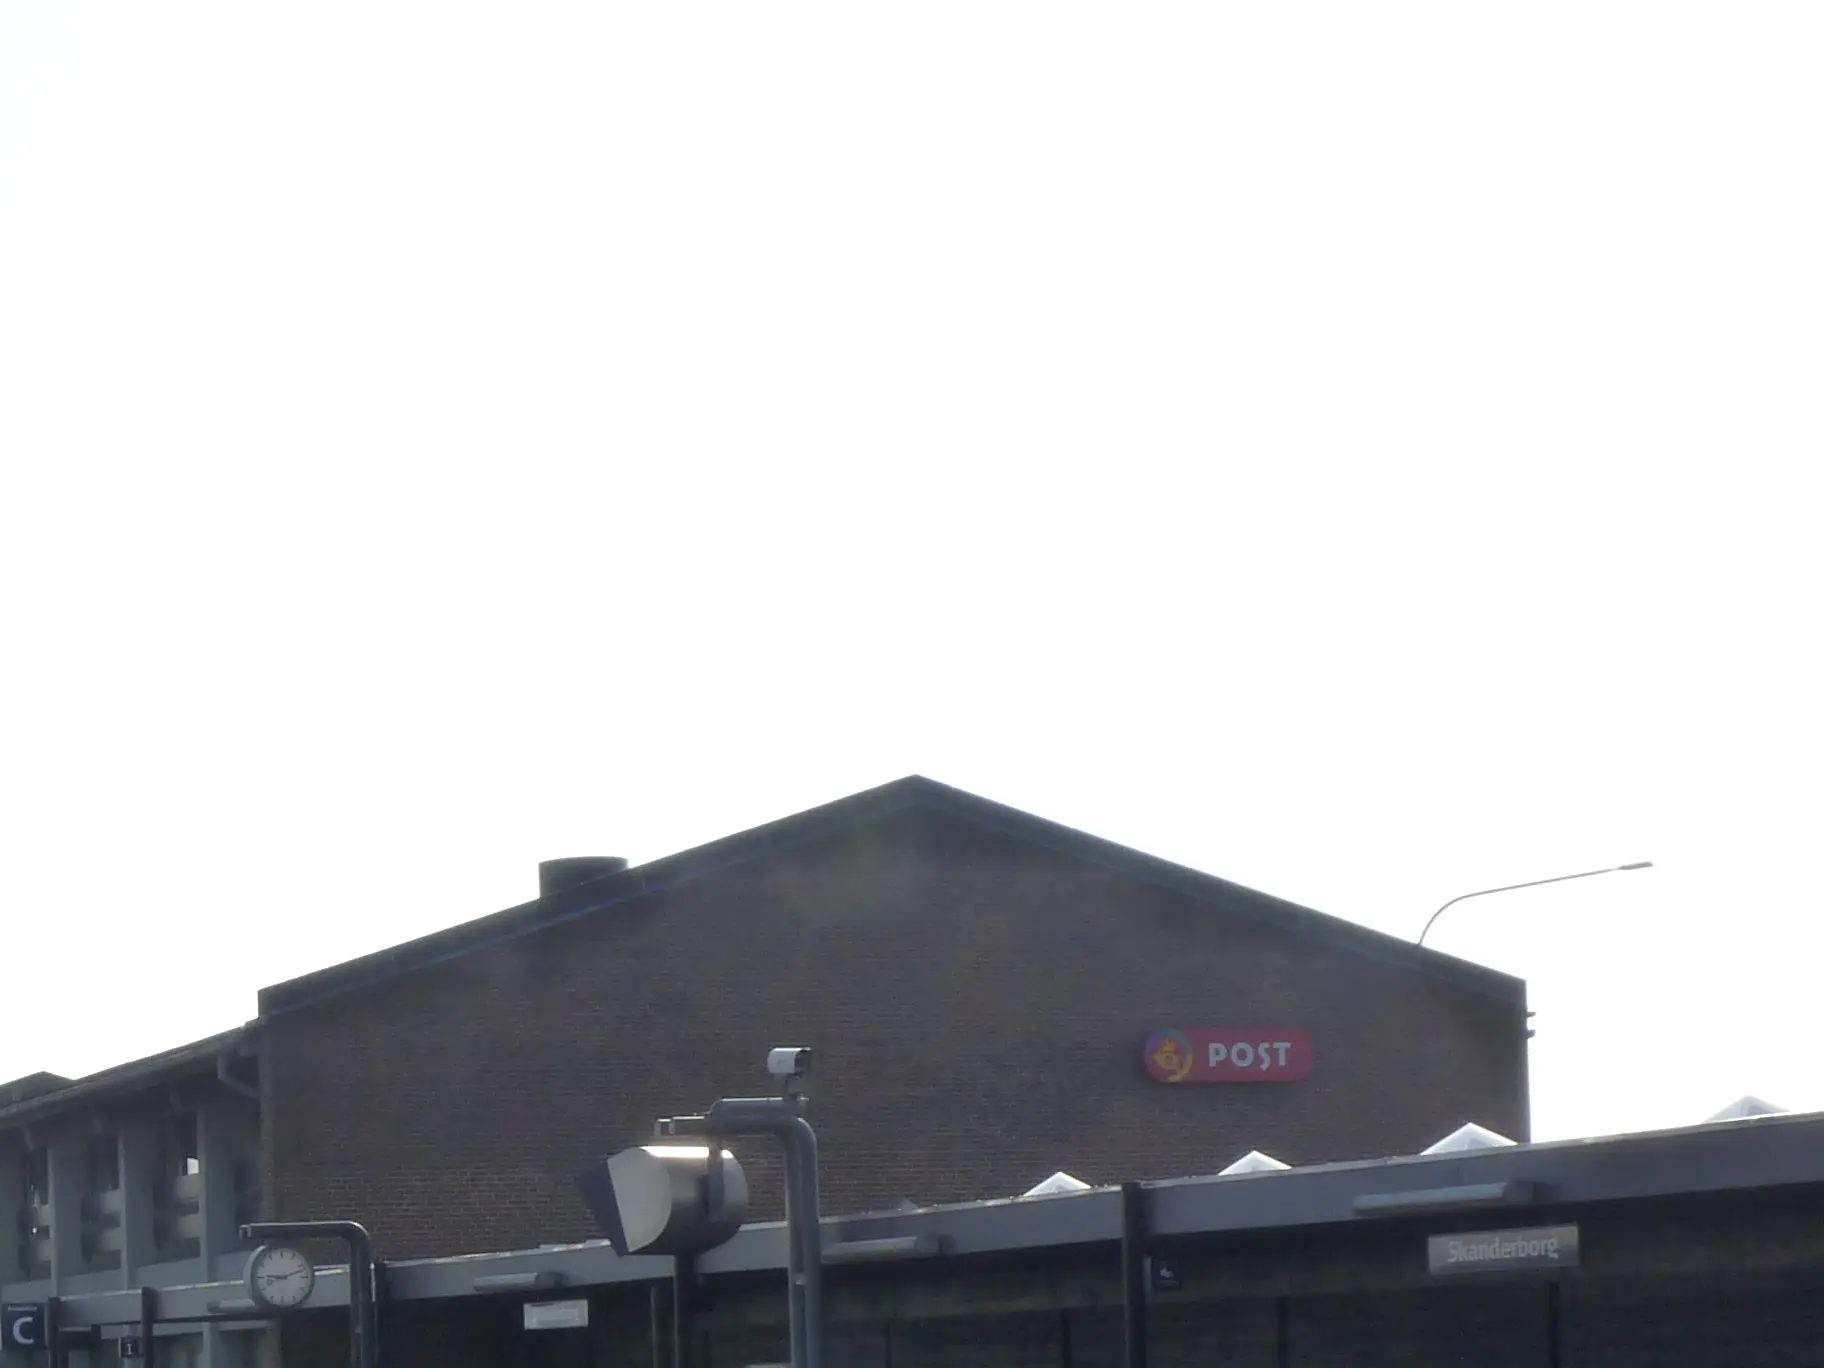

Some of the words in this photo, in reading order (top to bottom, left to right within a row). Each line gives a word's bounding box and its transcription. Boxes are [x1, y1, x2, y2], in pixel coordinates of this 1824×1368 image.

[1208, 1042, 1292, 1071] POST
[1447, 1235, 1561, 1263] Skanderborg
[12, 1316, 35, 1345] C
